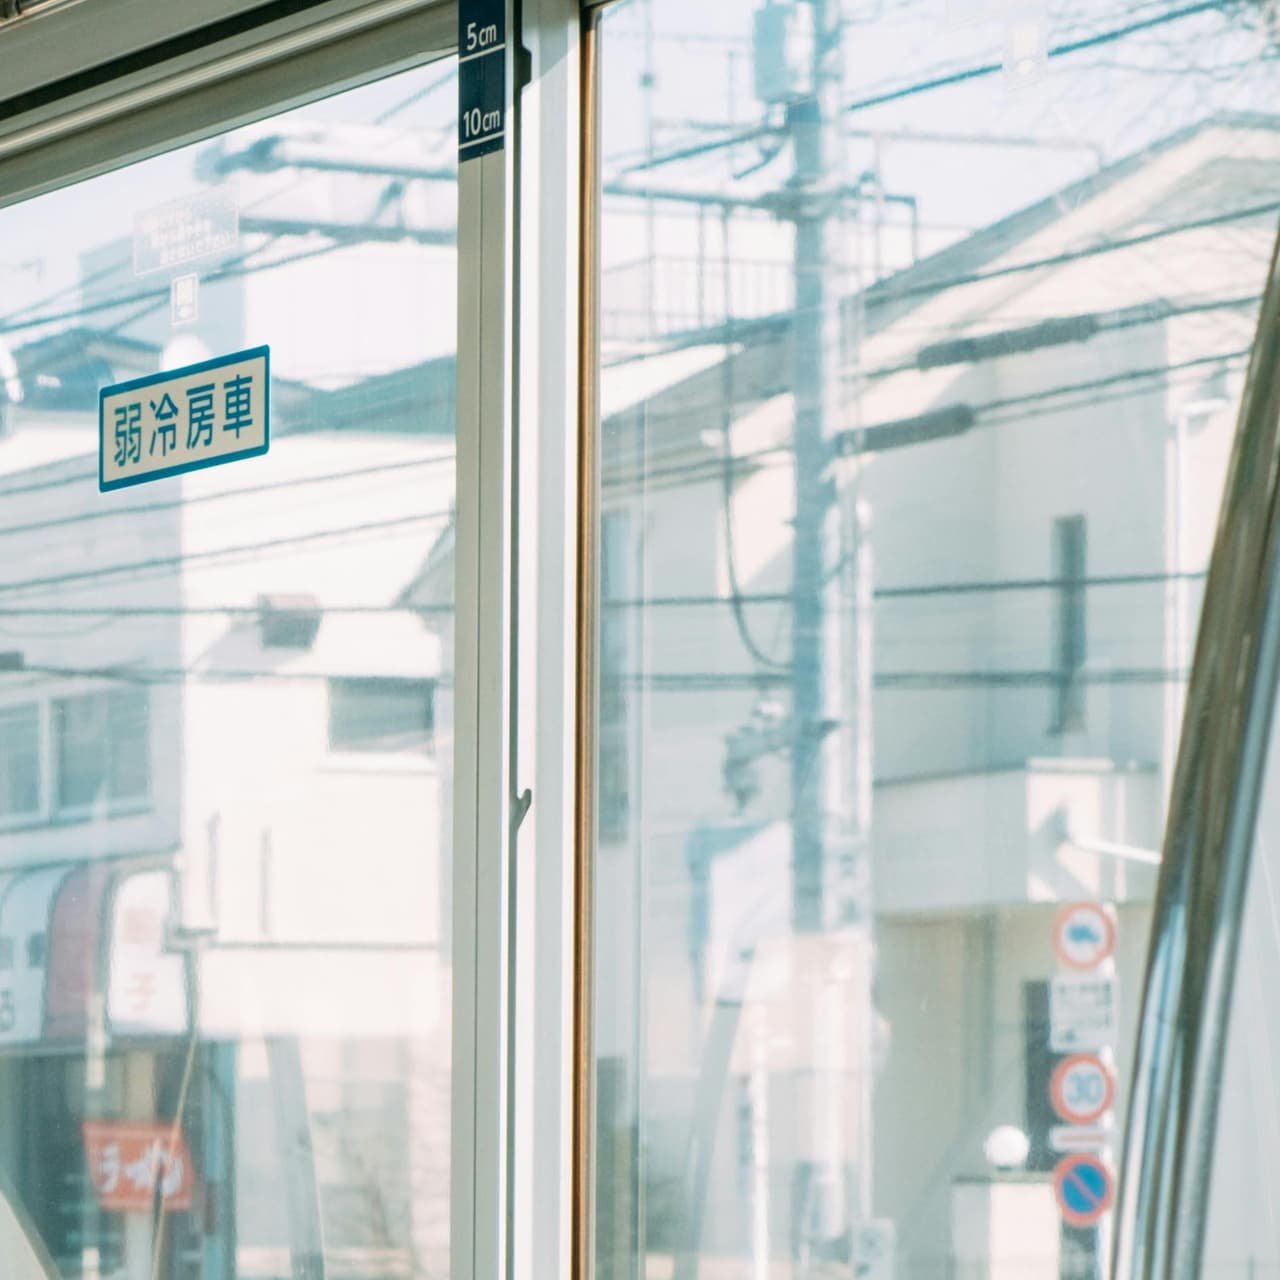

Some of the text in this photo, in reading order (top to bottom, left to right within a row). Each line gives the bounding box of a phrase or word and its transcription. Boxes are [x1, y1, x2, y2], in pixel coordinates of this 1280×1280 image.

[466, 22, 497, 50] 5cm
[463, 107, 501, 138] 10cm
[113, 374, 254, 468] 弱冷房車
[1065, 1071, 1104, 1105] 30
